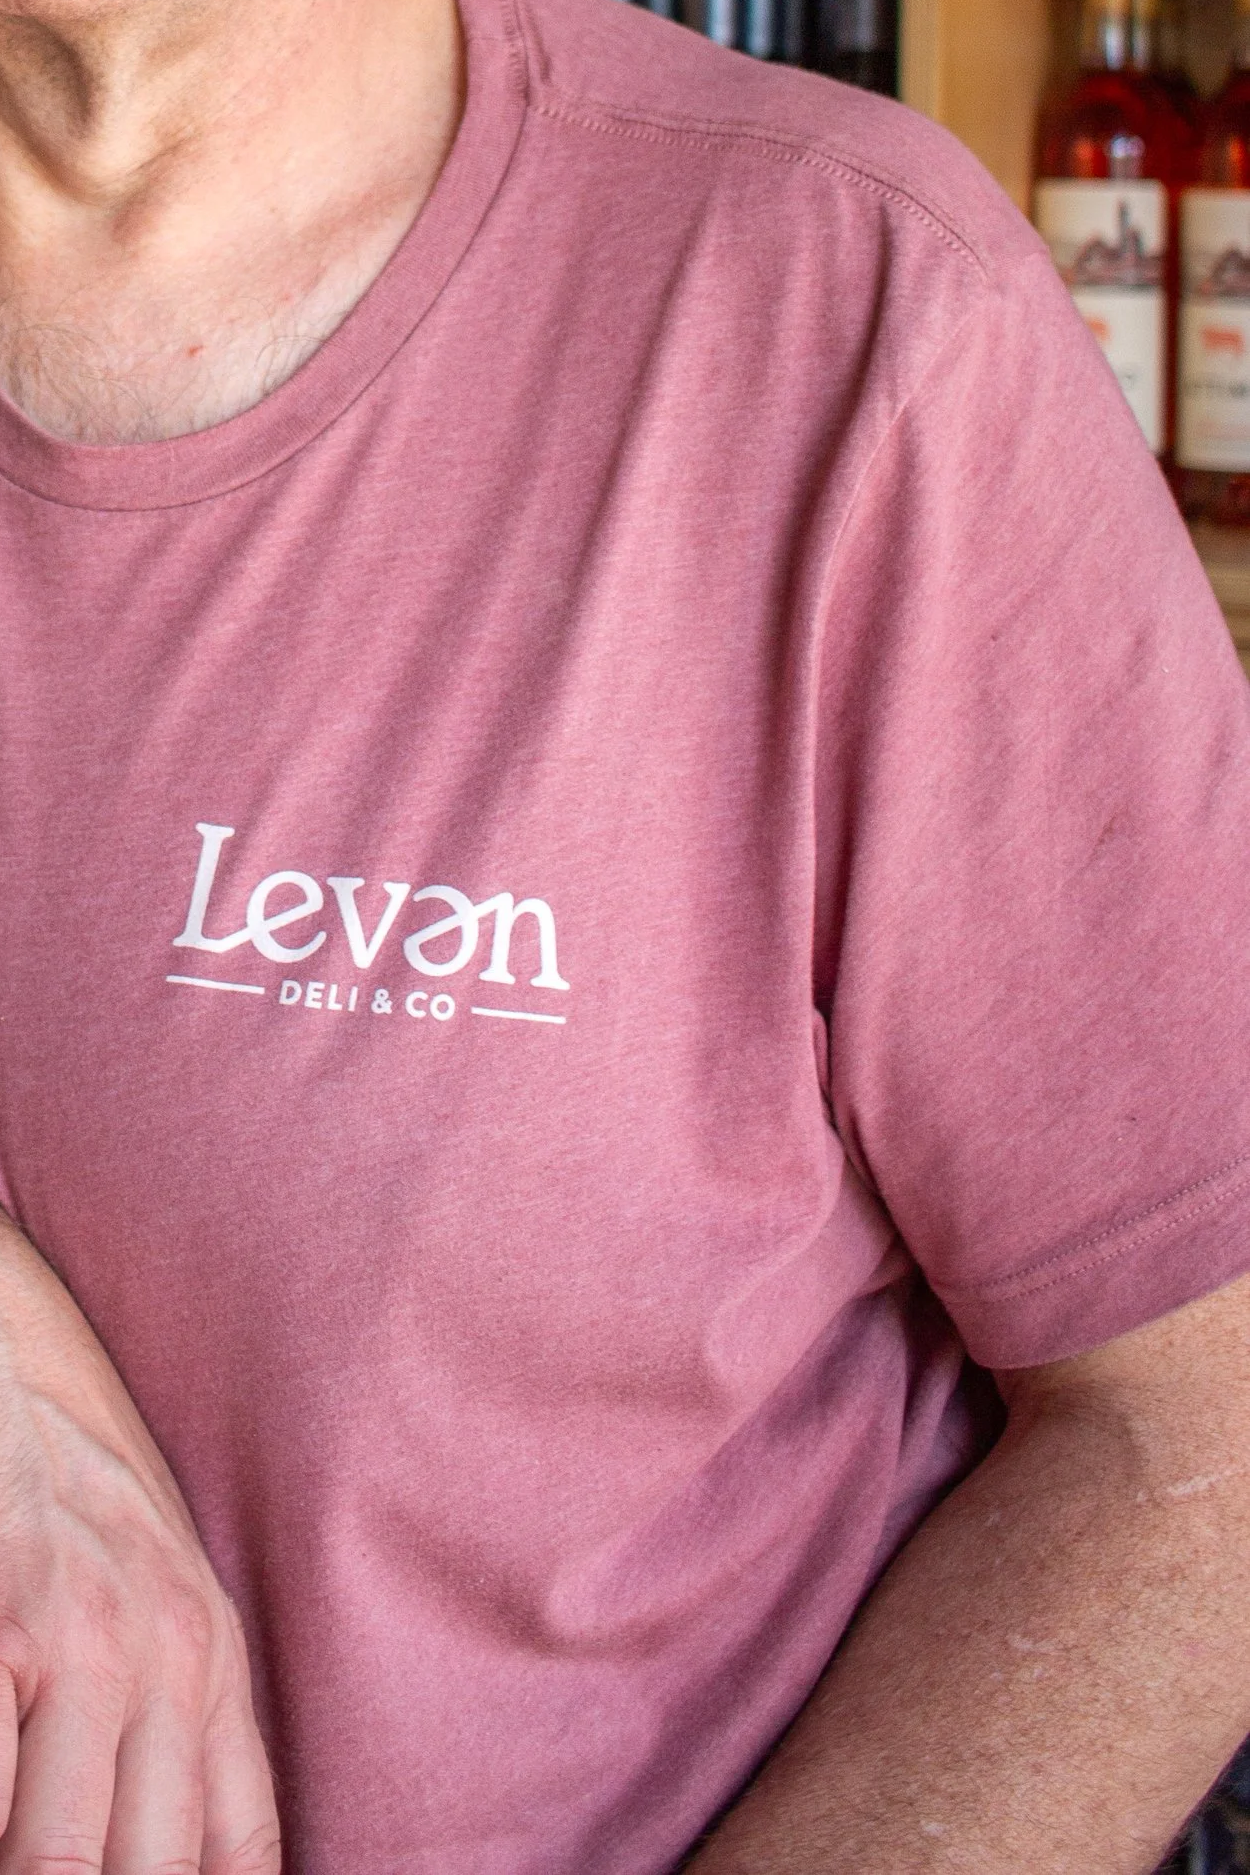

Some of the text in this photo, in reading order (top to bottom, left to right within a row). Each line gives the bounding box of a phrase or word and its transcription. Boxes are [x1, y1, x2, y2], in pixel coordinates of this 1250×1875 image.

[278, 979, 456, 1021] DELI & CO
